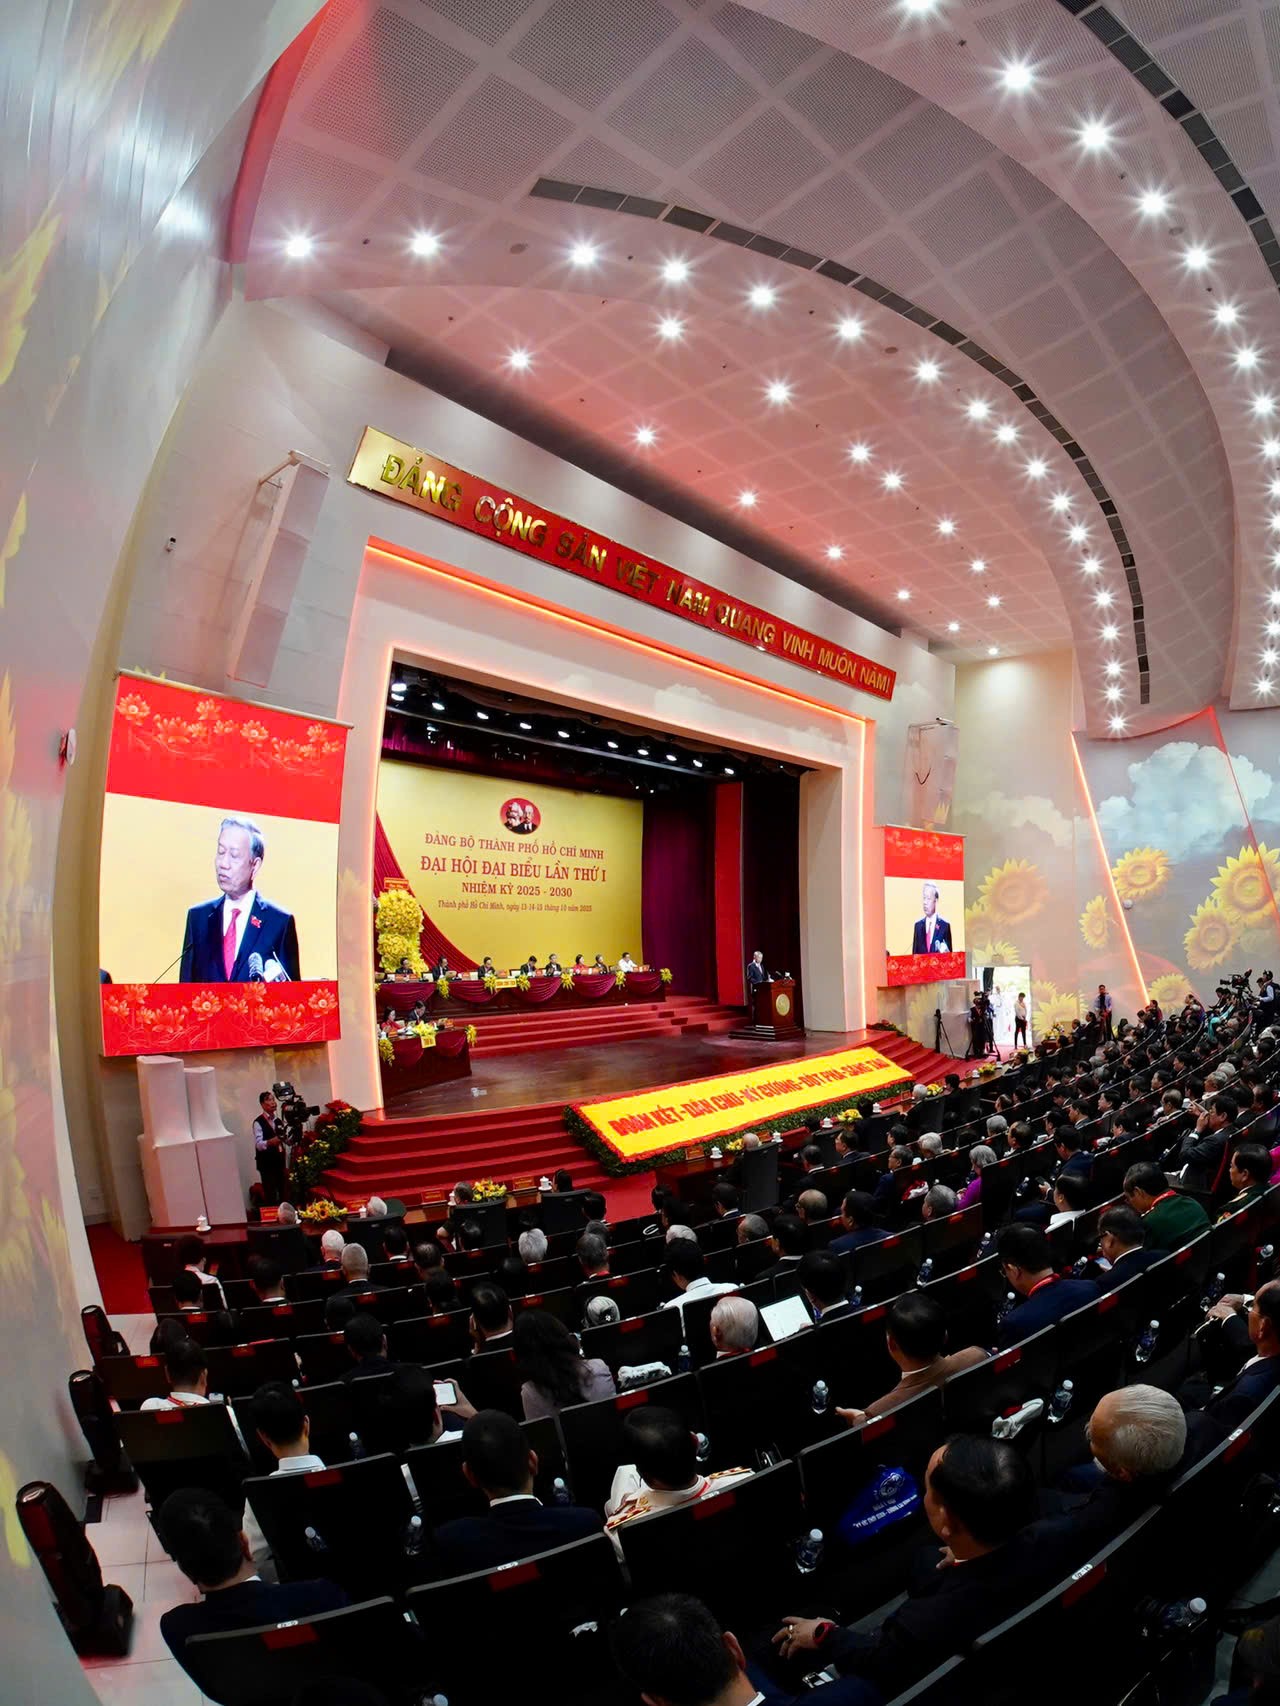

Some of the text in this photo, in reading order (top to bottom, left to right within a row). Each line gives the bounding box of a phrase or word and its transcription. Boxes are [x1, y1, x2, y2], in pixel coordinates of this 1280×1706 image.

[380, 454, 890, 694] ĐẢNG CỘNG SẢN VIỆT NAM QUANG VINH MUÔN NĂM!
[425, 831, 456, 846] ĐẢNG
[459, 835, 475, 851] BỘ
[478, 838, 515, 851] THÀNH
[518, 837, 539, 854] PHỐ
[560, 845, 577, 857] CHÍ
[579, 849, 604, 859] MINH
[421, 855, 606, 882] ĐẠI HỘI ĐẠI BIỂU LẦN THỨ I
[462, 881, 496, 896] NHIỆM
[516, 886, 540, 896] 2025
[549, 887, 572, 897] 2030
